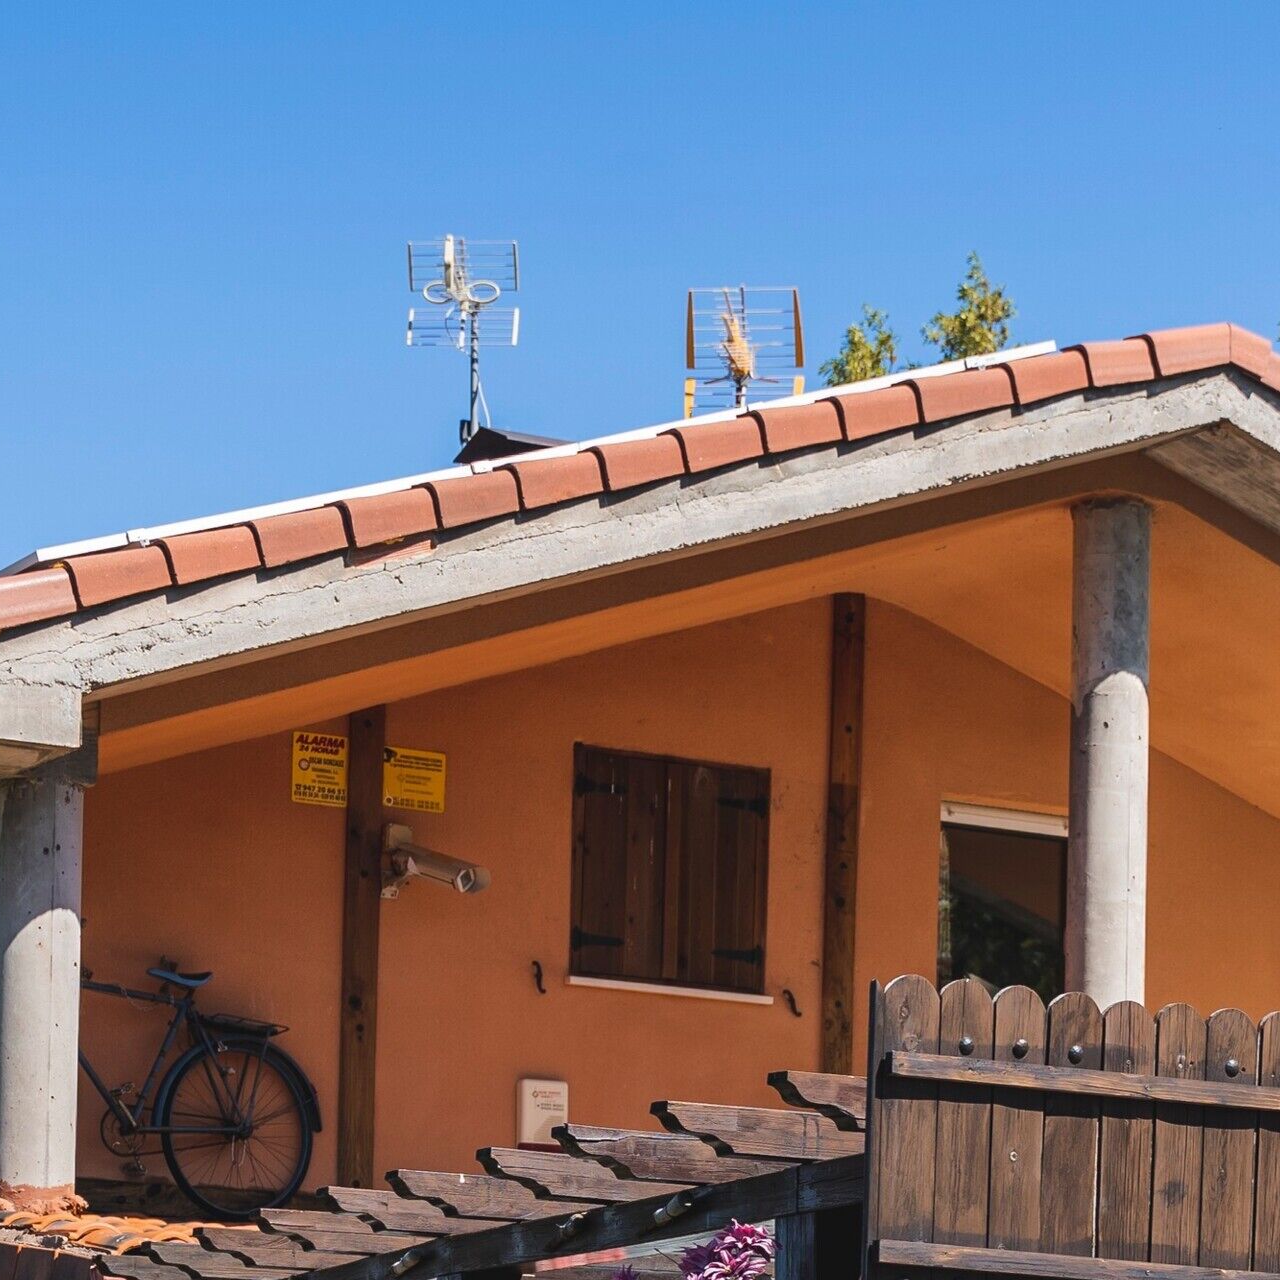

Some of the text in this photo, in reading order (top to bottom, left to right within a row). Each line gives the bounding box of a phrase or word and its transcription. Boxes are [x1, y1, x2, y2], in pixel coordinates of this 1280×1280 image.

[296, 734, 345, 749] ALARMA
[299, 744, 340, 755] 24 HORAS
